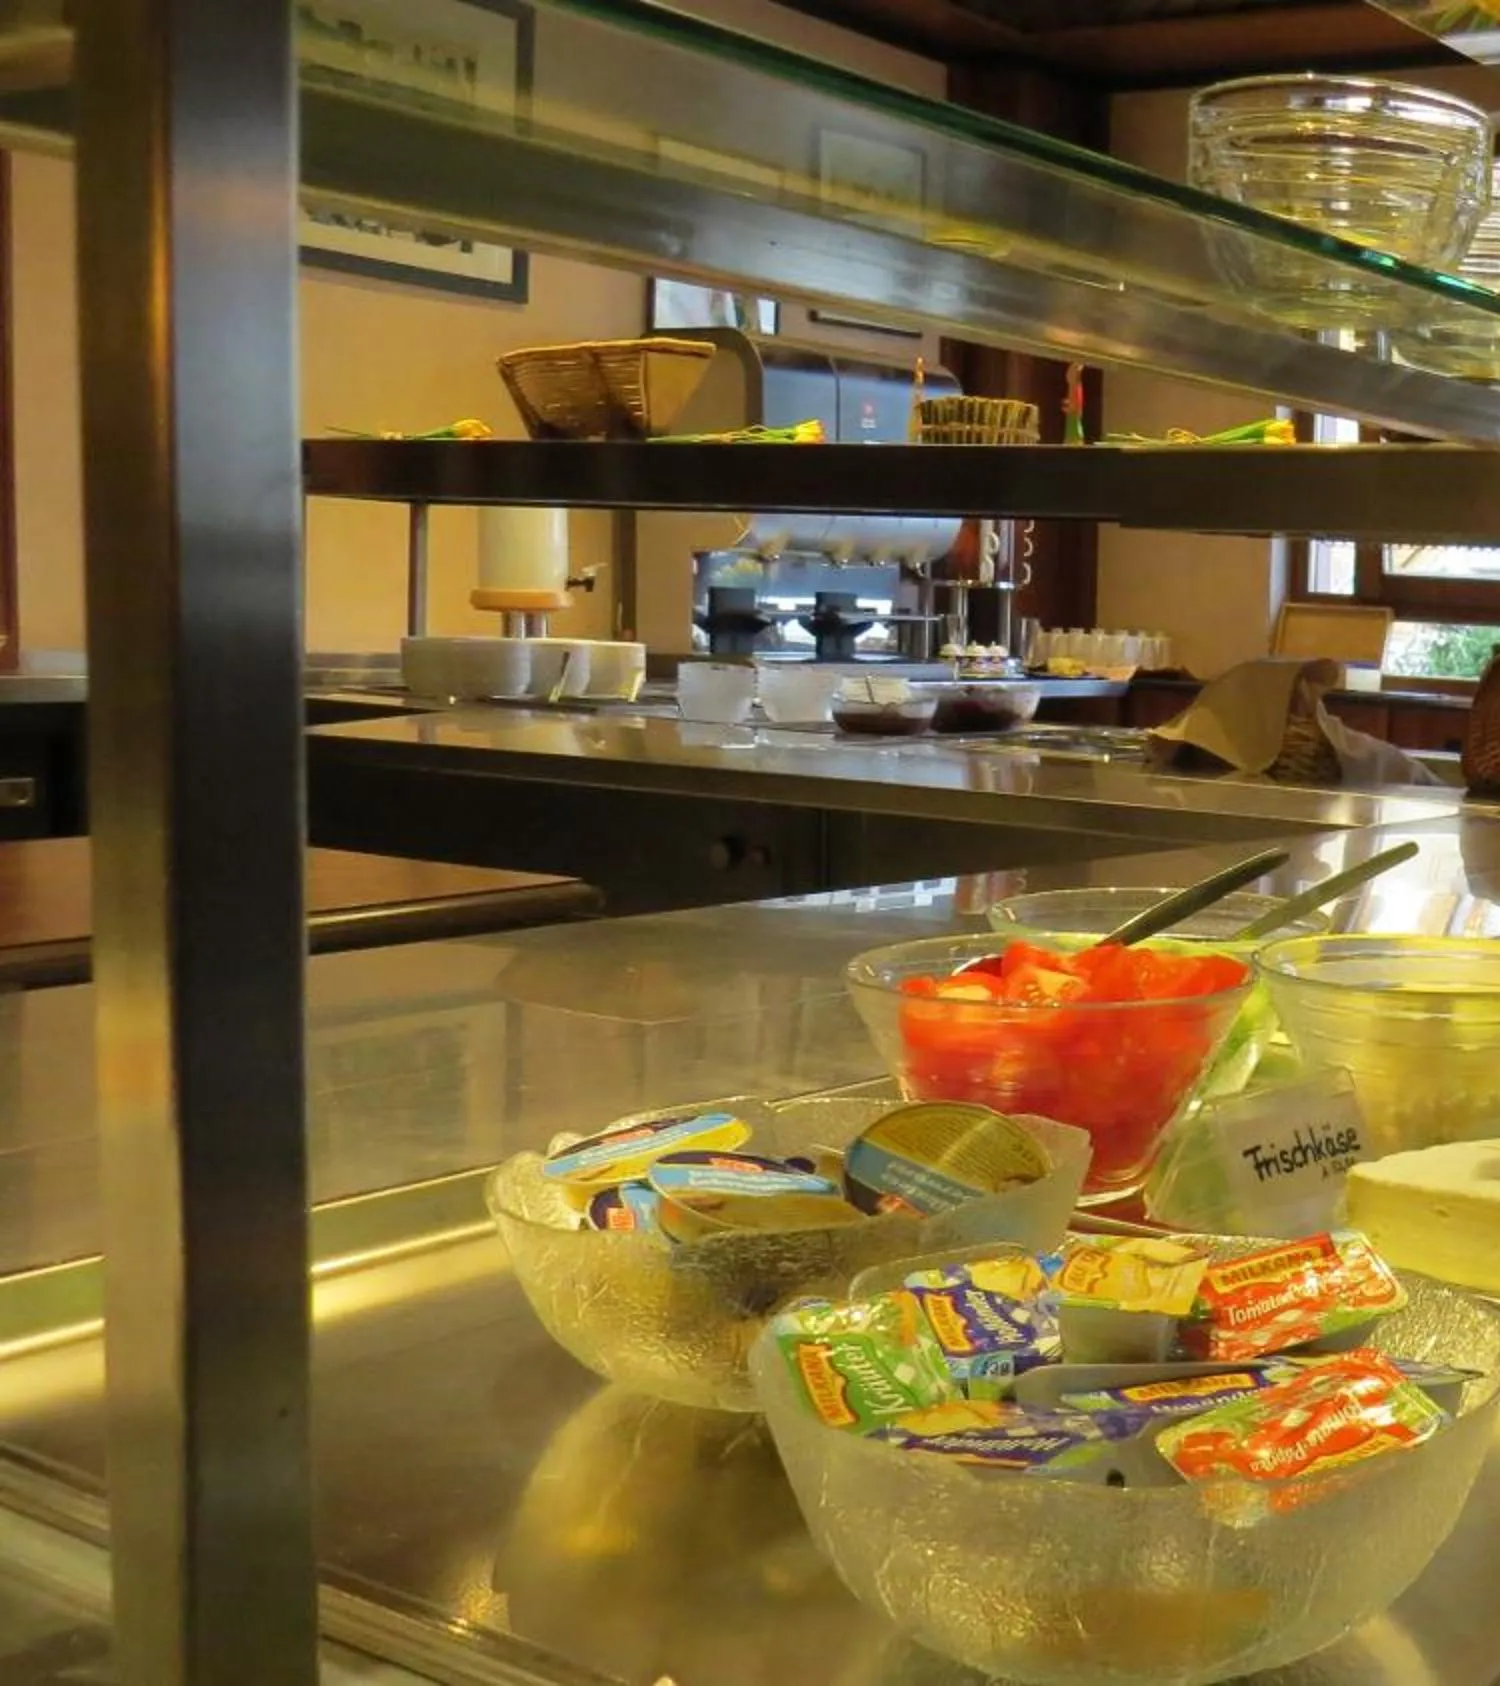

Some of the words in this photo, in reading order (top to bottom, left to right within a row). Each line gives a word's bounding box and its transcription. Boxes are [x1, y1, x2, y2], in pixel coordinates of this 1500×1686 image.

[1243, 1122, 1361, 1182] Frischkäse
[1221, 1246, 1316, 1285] MILKANA
[843, 1344, 914, 1415] Kräuter
